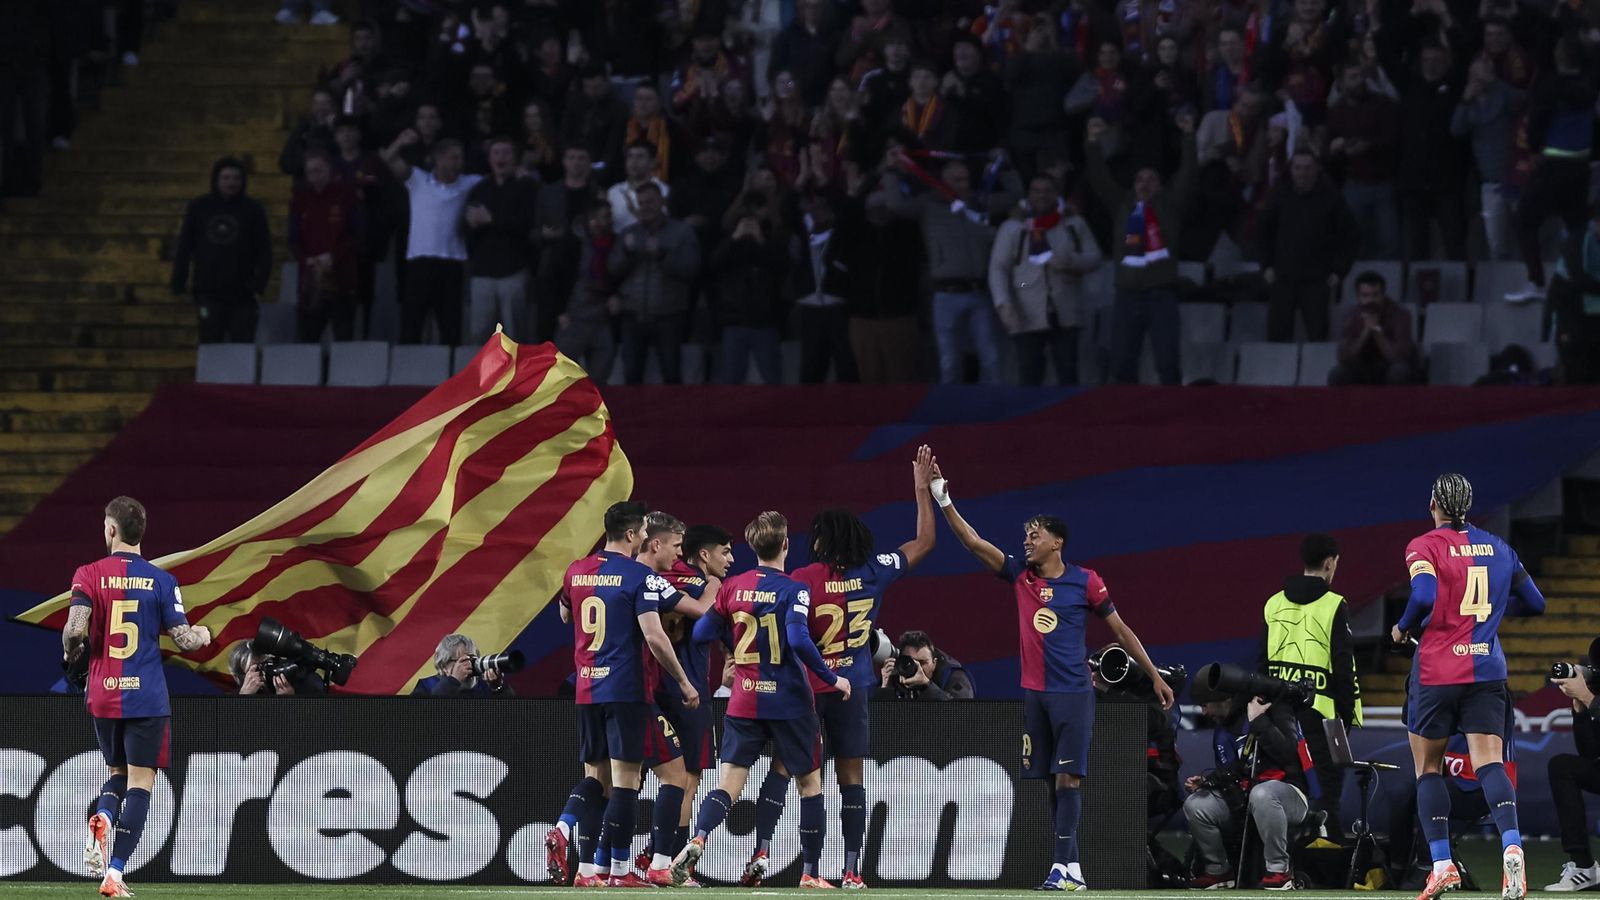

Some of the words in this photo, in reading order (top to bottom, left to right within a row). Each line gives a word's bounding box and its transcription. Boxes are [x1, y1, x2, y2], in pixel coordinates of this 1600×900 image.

[1449, 545, 1459, 557] R.
[1460, 544, 1494, 556] ARAUJO
[108, 576, 154, 590] MARTINEZ
[825, 578, 863, 593] KOUNDE
[1459, 566, 1491, 622] 4
[108, 599, 139, 659] 5
[580, 595, 606, 651] 9
[732, 611, 781, 665] 21
[815, 598, 874, 655] 23
